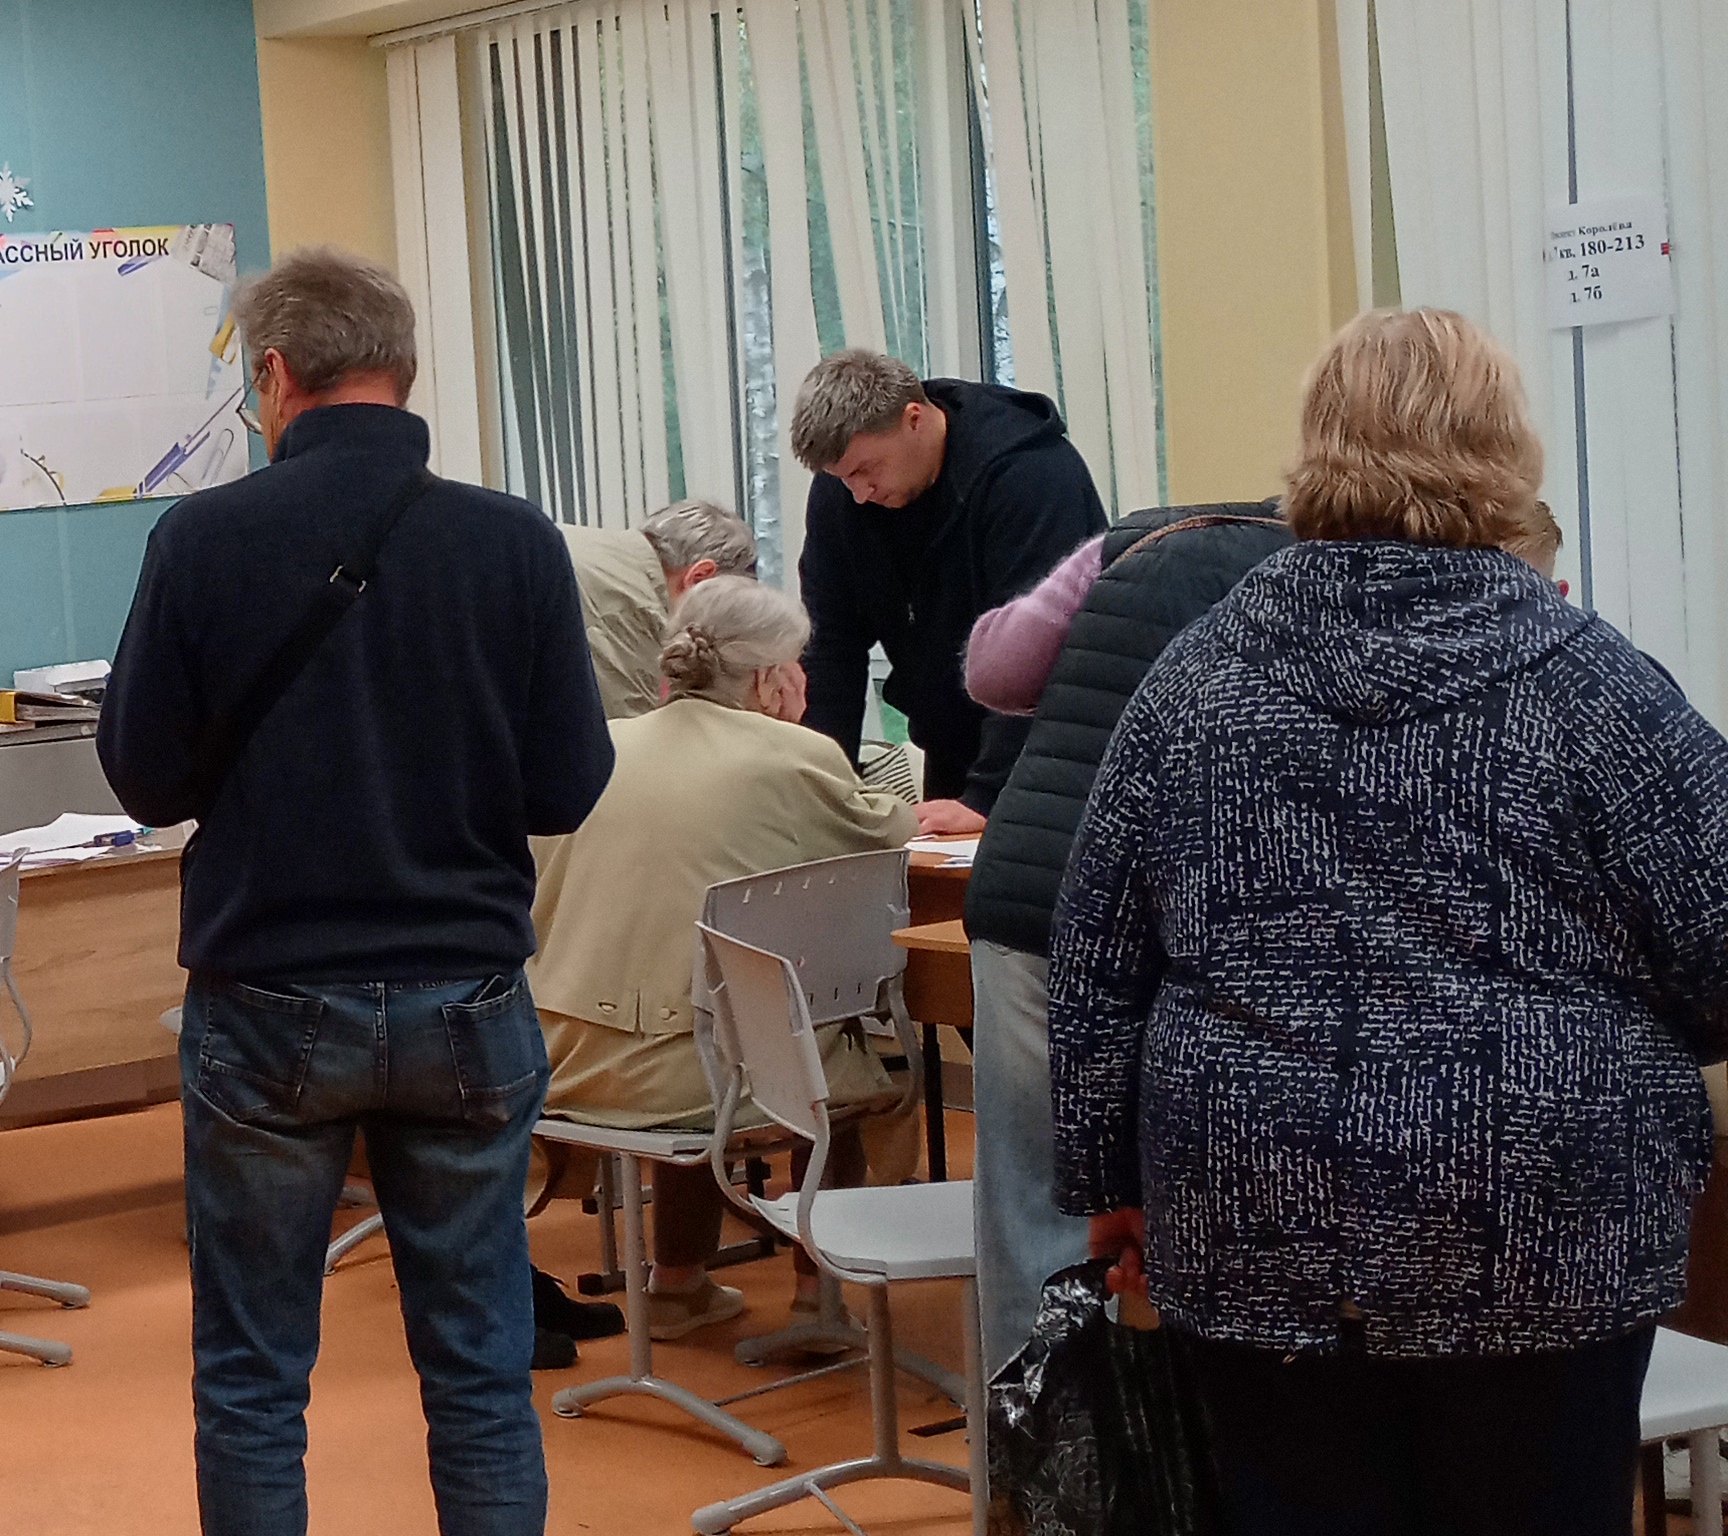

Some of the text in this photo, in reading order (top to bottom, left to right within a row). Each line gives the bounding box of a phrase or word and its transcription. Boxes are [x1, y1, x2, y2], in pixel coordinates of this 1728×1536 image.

[88, 238, 170, 260] УГОЛОК
[1580, 233, 1645, 257] 180-213
[1581, 264, 1600, 278] 7а
